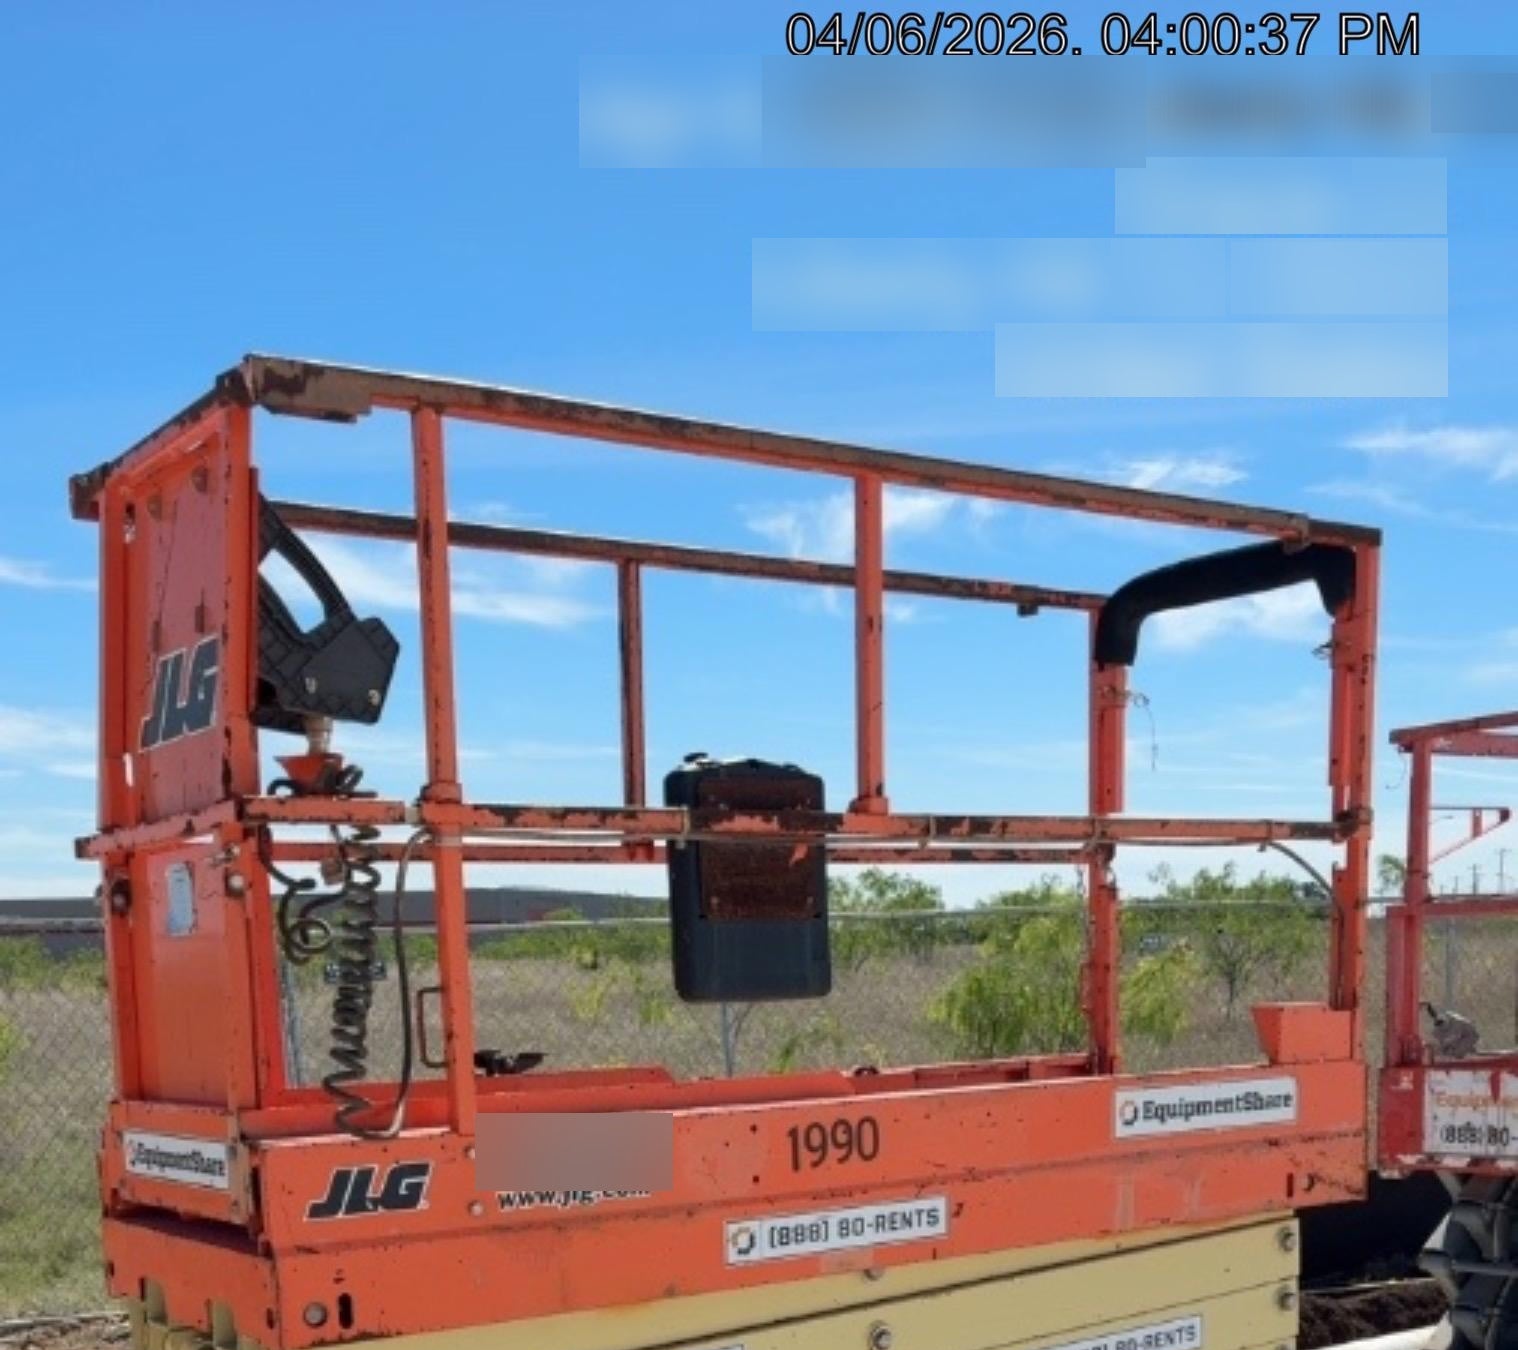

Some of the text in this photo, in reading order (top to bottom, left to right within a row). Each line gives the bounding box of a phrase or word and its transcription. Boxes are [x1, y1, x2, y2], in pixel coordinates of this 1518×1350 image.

[138, 633, 219, 753] JLG
[1142, 1091, 1293, 1123] EquipmentShare
[134, 1142, 226, 1177] EquipmentShare
[786, 1115, 880, 1173] 1990
[302, 1160, 432, 1221] JLG
[497, 1190, 651, 1210] www.jlg.
